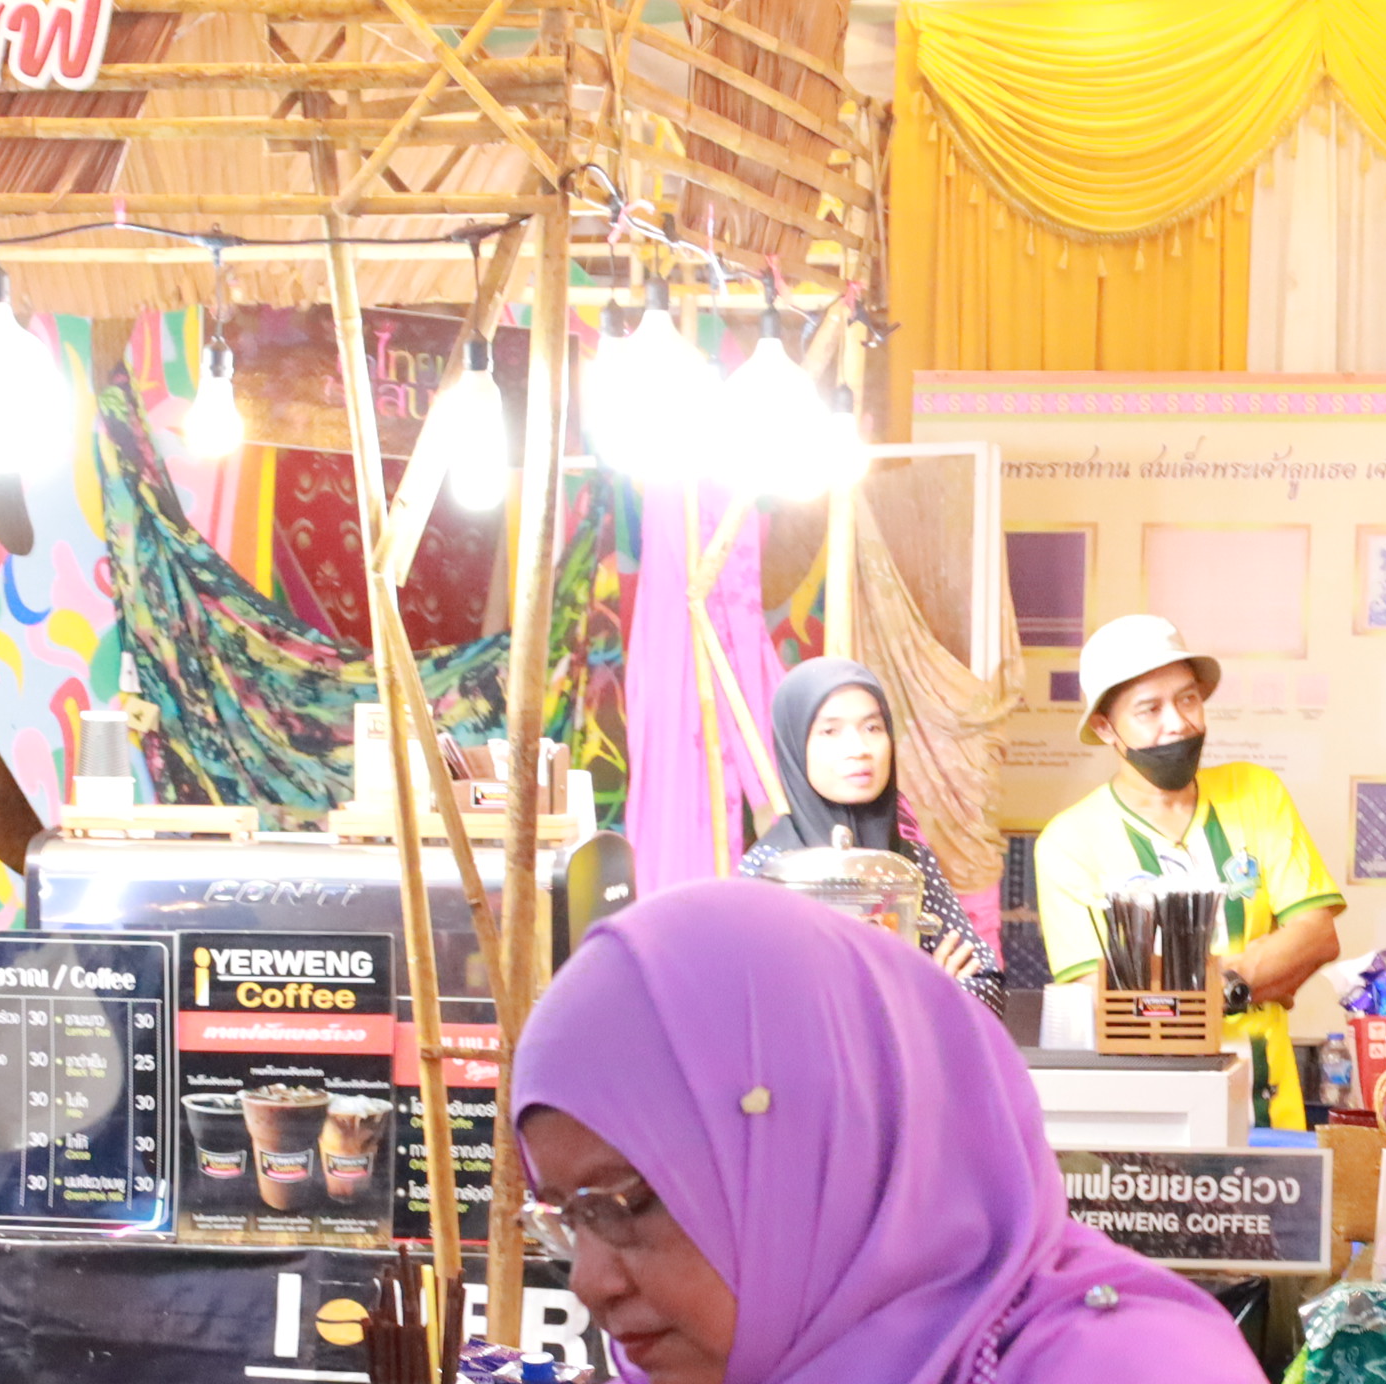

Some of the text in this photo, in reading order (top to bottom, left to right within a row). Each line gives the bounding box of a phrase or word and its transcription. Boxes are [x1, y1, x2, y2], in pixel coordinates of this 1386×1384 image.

[210, 948, 375, 977] YERWENG
[70, 966, 137, 991] Coffee
[236, 982, 357, 1010] Coffee
[28, 1009, 48, 1027] 30
[134, 1012, 155, 1030] 30
[29, 1051, 49, 1068] 30
[134, 1054, 156, 1072] 25
[29, 1091, 49, 1108] 30
[135, 1094, 156, 1111] 30
[28, 1131, 49, 1148] 30
[134, 1135, 155, 1153] 30
[27, 1174, 48, 1191] 30
[133, 1175, 154, 1193] 30
[1187, 1213, 1272, 1235] COFFEE
